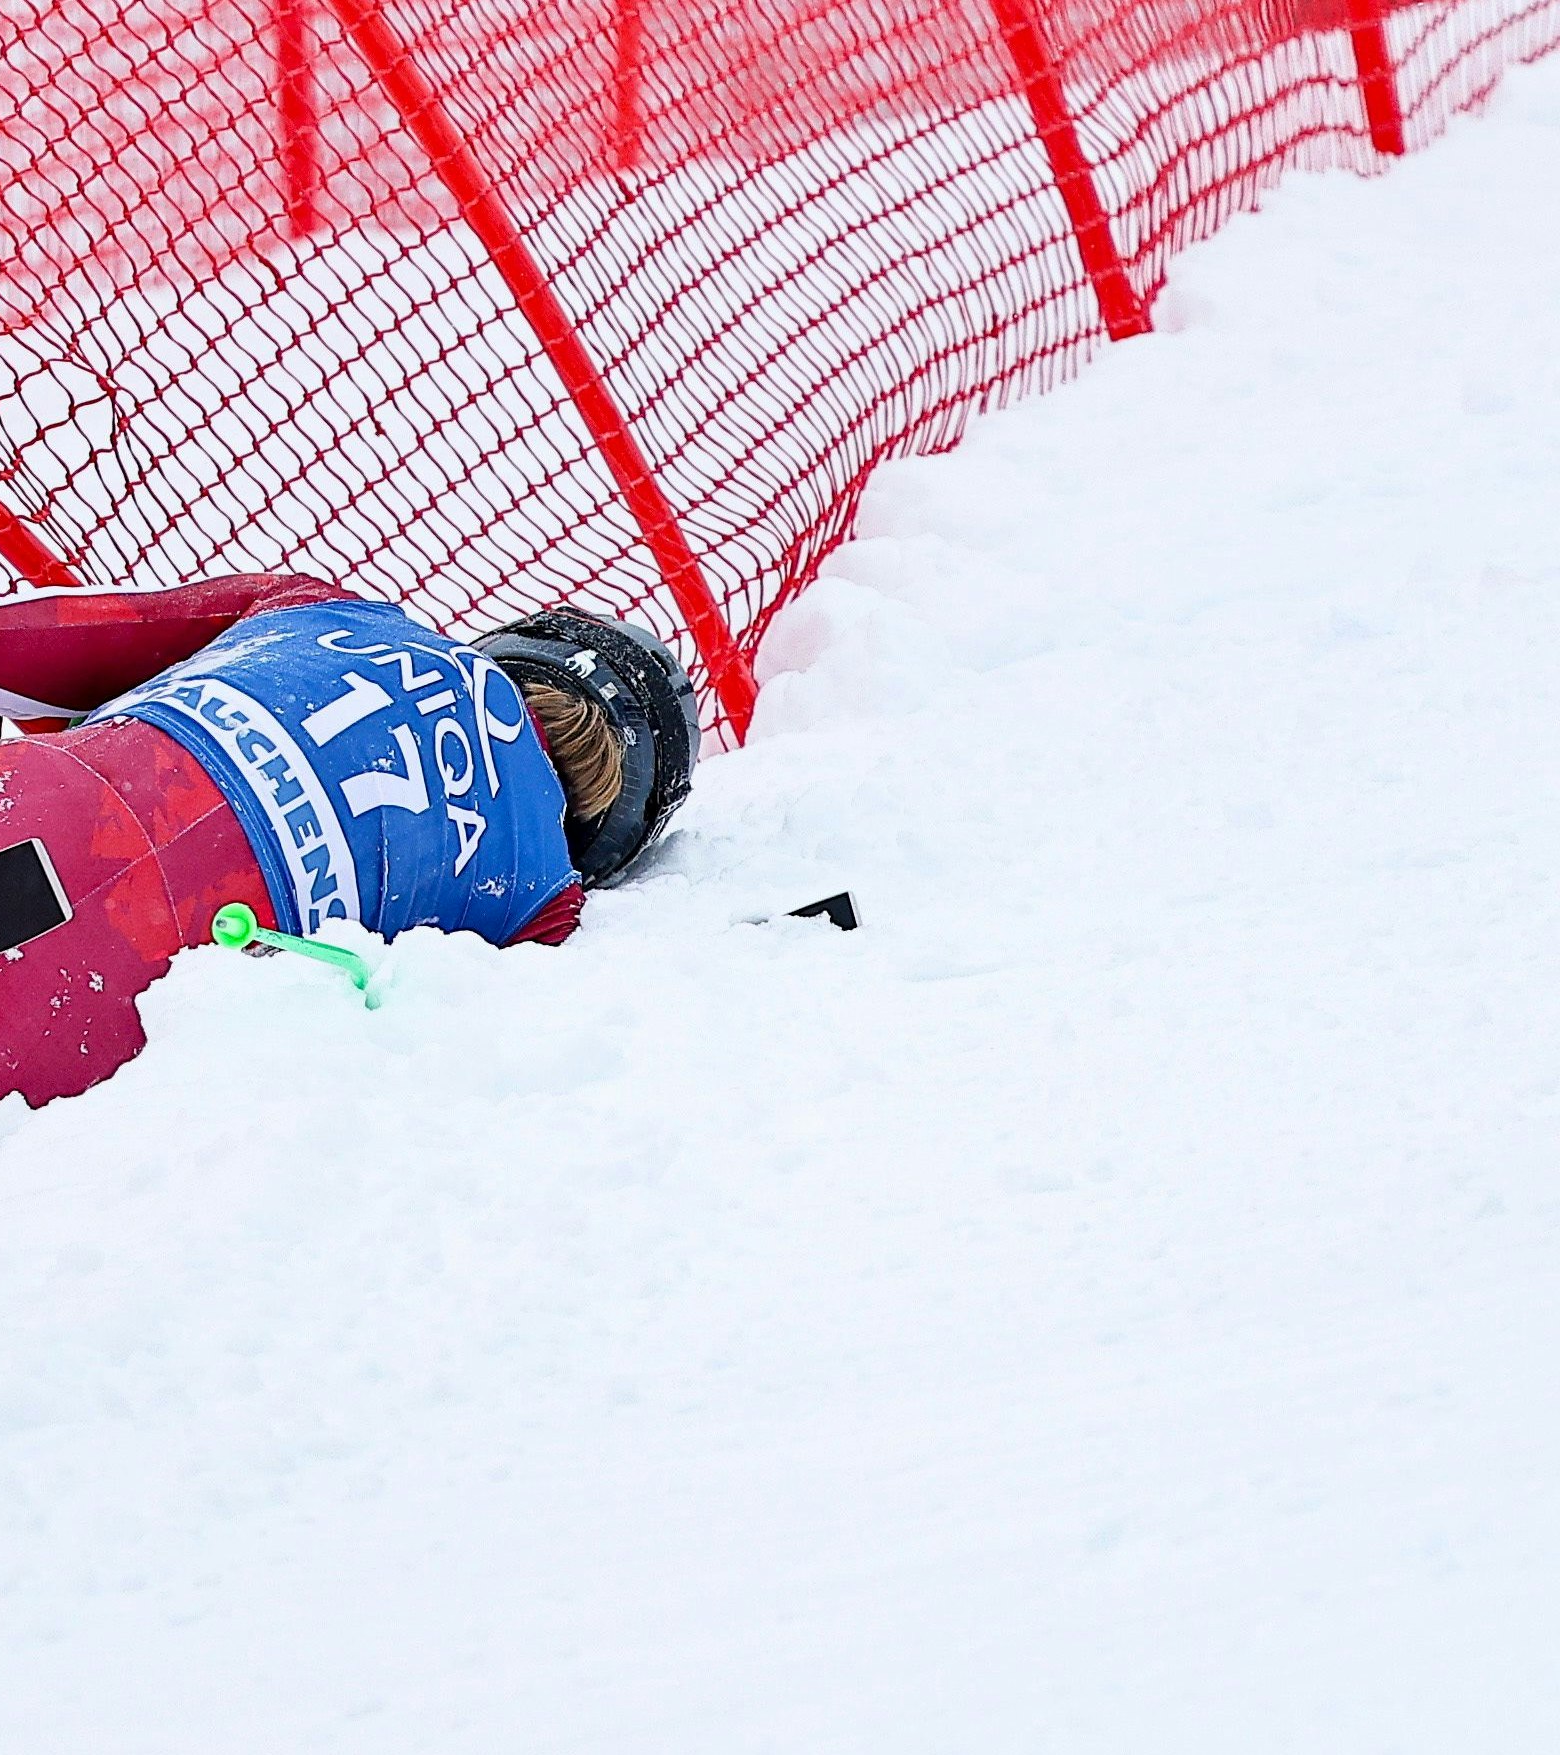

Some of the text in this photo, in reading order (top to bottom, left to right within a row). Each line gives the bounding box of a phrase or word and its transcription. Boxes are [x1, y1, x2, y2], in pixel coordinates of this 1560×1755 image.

[154, 684, 347, 935] AUCHENS
[301, 671, 430, 818] 17
[316, 630, 487, 878] UNIQA
